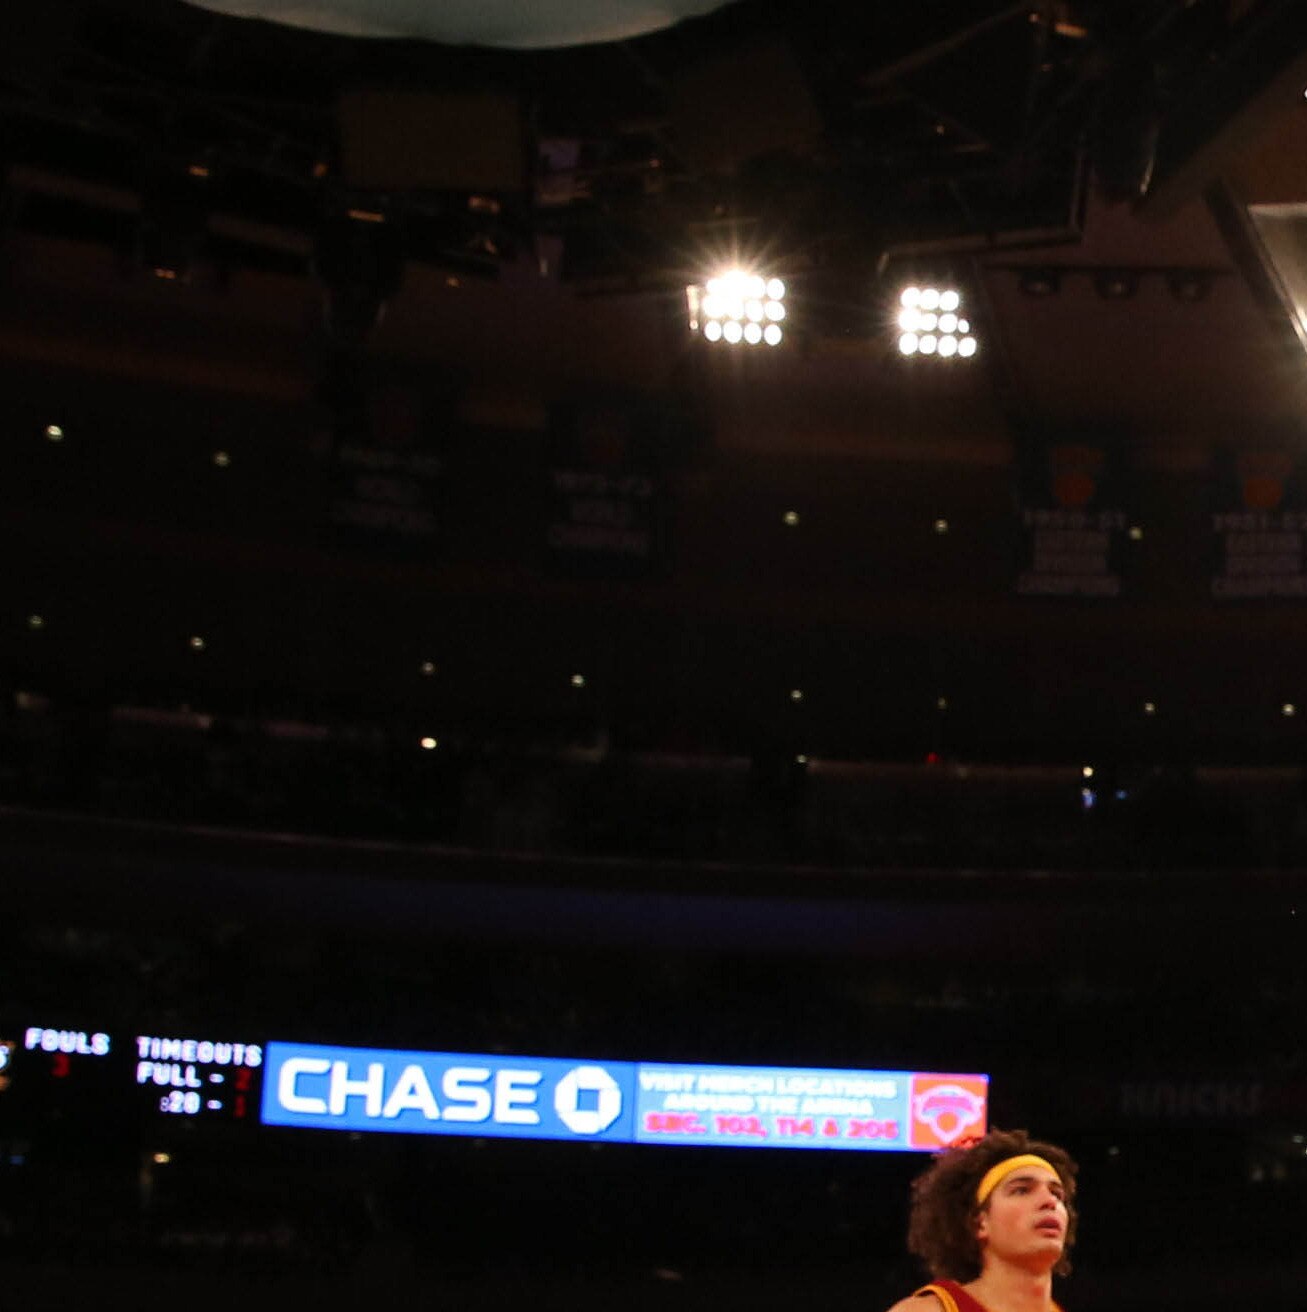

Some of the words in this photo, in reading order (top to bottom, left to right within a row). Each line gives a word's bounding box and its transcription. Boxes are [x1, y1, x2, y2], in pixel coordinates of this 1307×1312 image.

[25, 1027, 110, 1056] FOULS
[136, 1035, 262, 1067] TIMEOUTS
[136, 1061, 202, 1088] FULL
[278, 1058, 541, 1124] CHASE
